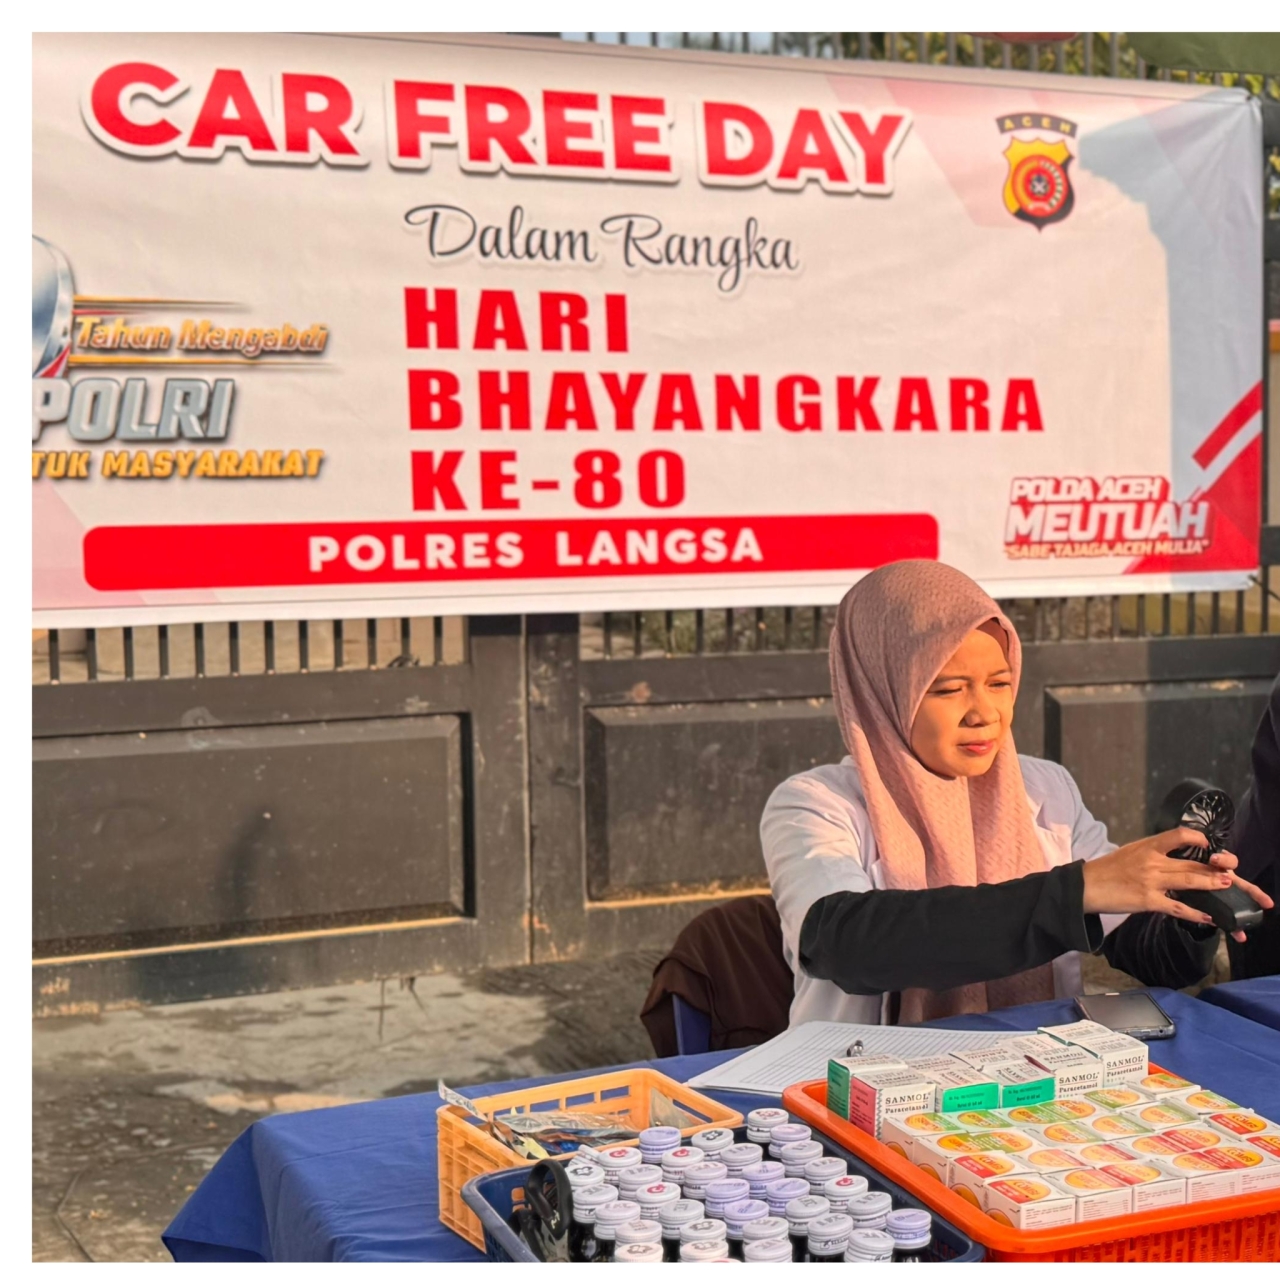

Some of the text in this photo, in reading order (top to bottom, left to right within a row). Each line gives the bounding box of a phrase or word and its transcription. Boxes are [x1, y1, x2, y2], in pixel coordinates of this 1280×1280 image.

[89, 60, 908, 187] CAR FREE DAY
[1004, 115, 1072, 134] ACEH
[404, 204, 799, 293] Dalam Rangka
[75, 316, 329, 357] Tahun Mengabdi
[403, 286, 629, 354] HARI
[32, 377, 236, 441] POLRI
[407, 369, 1044, 432] BHAYANGKARA
[32, 450, 324, 479] TUK MASYARAKAT
[411, 449, 686, 512] KE-80
[1010, 475, 1167, 503] POLDA ACEH
[1004, 502, 1211, 543] MEUTUAH
[308, 527, 764, 572] POLRES LANGSA
[1058, 1071, 1099, 1084] SANMOL
[1106, 1054, 1144, 1069] SANMOL
[1106, 1065, 1144, 1078] Paracetamol
[885, 1093, 930, 1105] SANMOL
[1058, 1082, 1099, 1094] Paracetamol
[885, 1103, 929, 1114] Paracetamol
